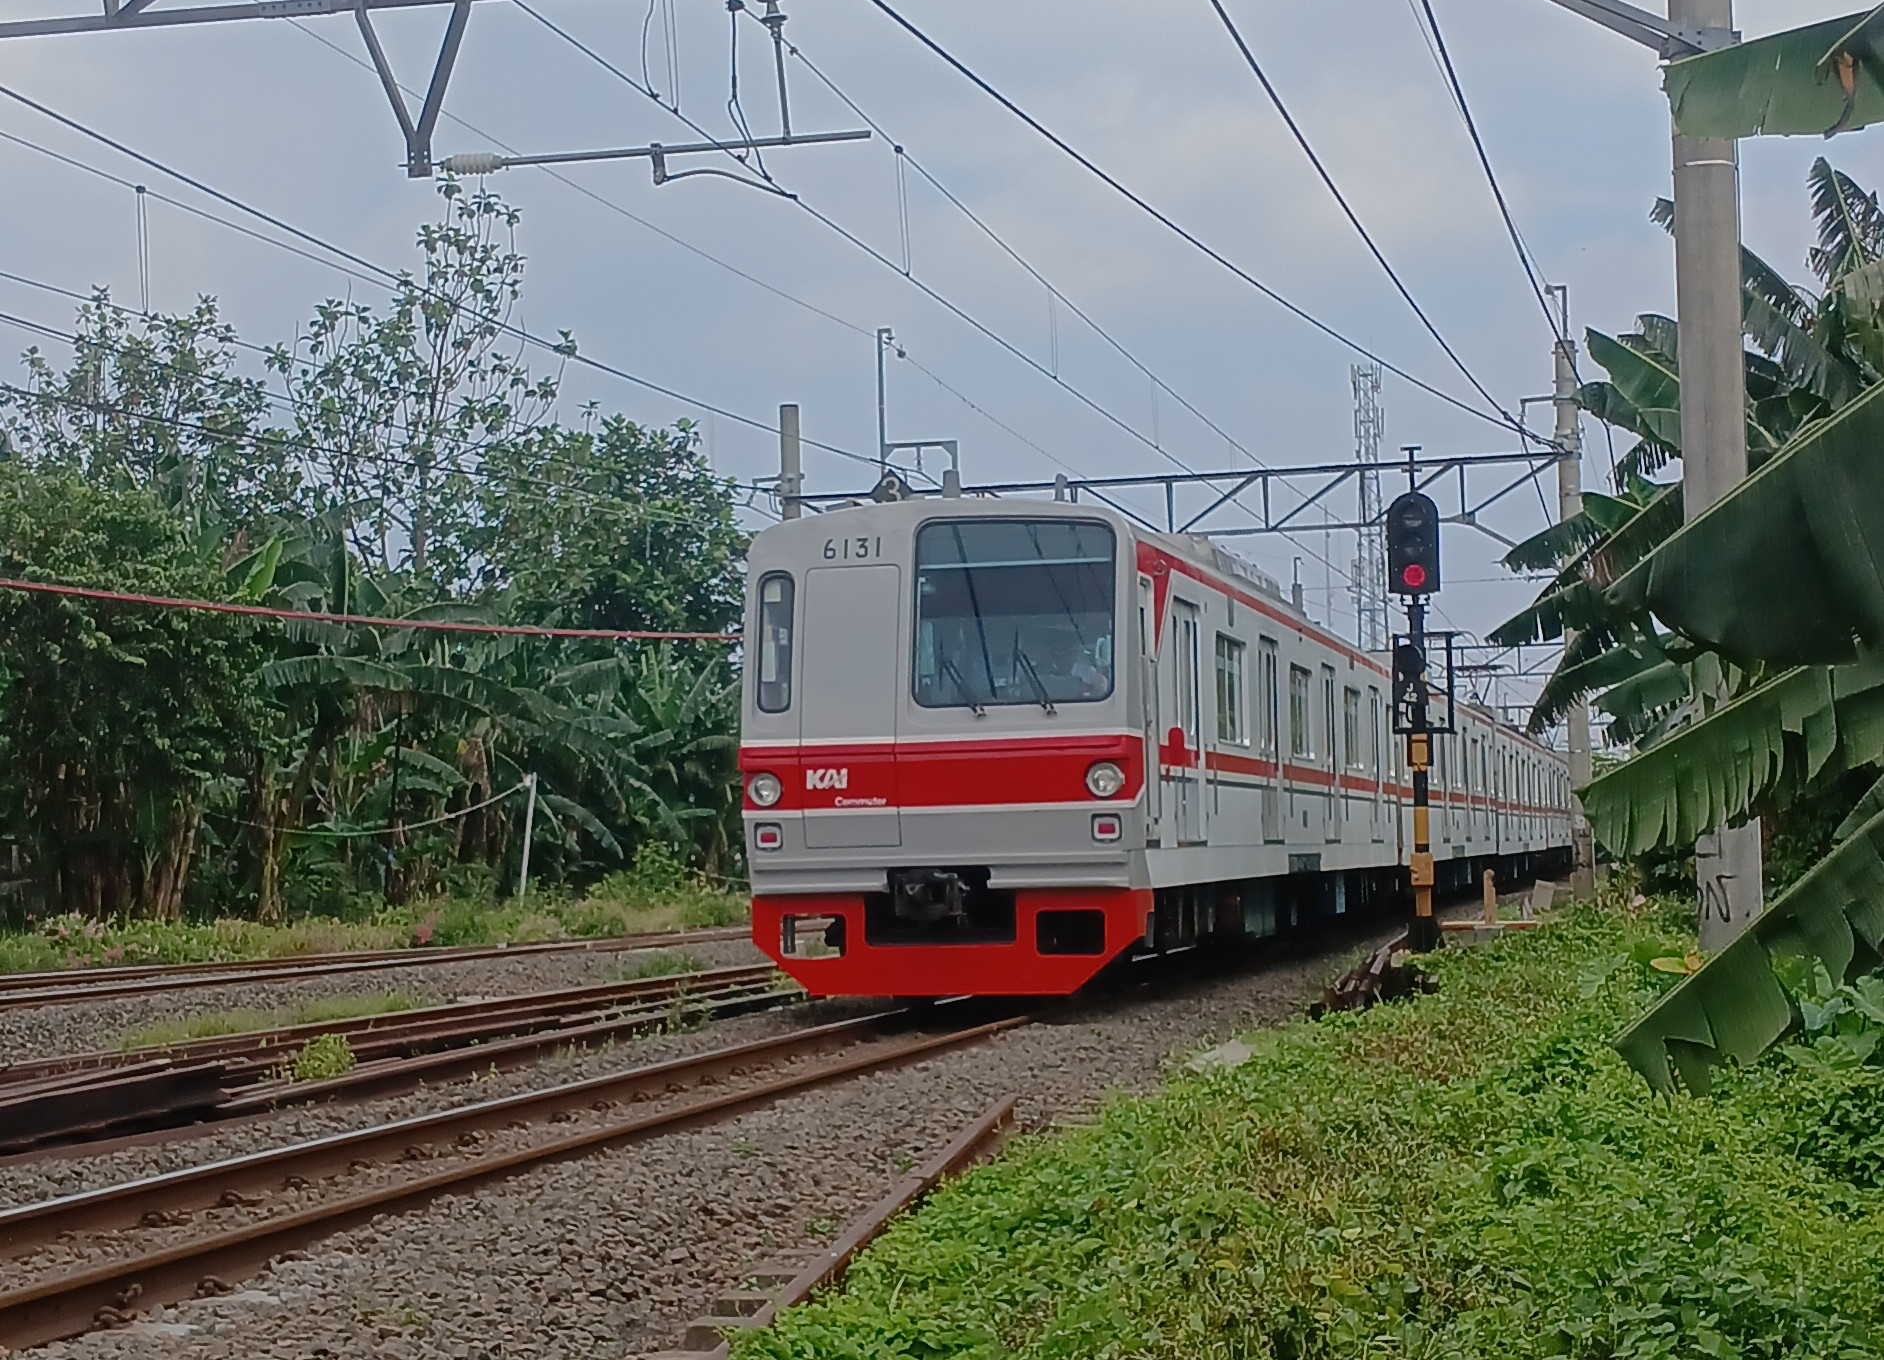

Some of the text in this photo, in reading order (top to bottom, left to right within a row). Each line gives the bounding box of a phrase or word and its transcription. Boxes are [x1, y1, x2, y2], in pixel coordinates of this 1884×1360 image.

[823, 536, 881, 560] 6131
[1406, 682, 1414, 692] J
[806, 768, 848, 790] KAI
[834, 796, 887, 807] Commuter
